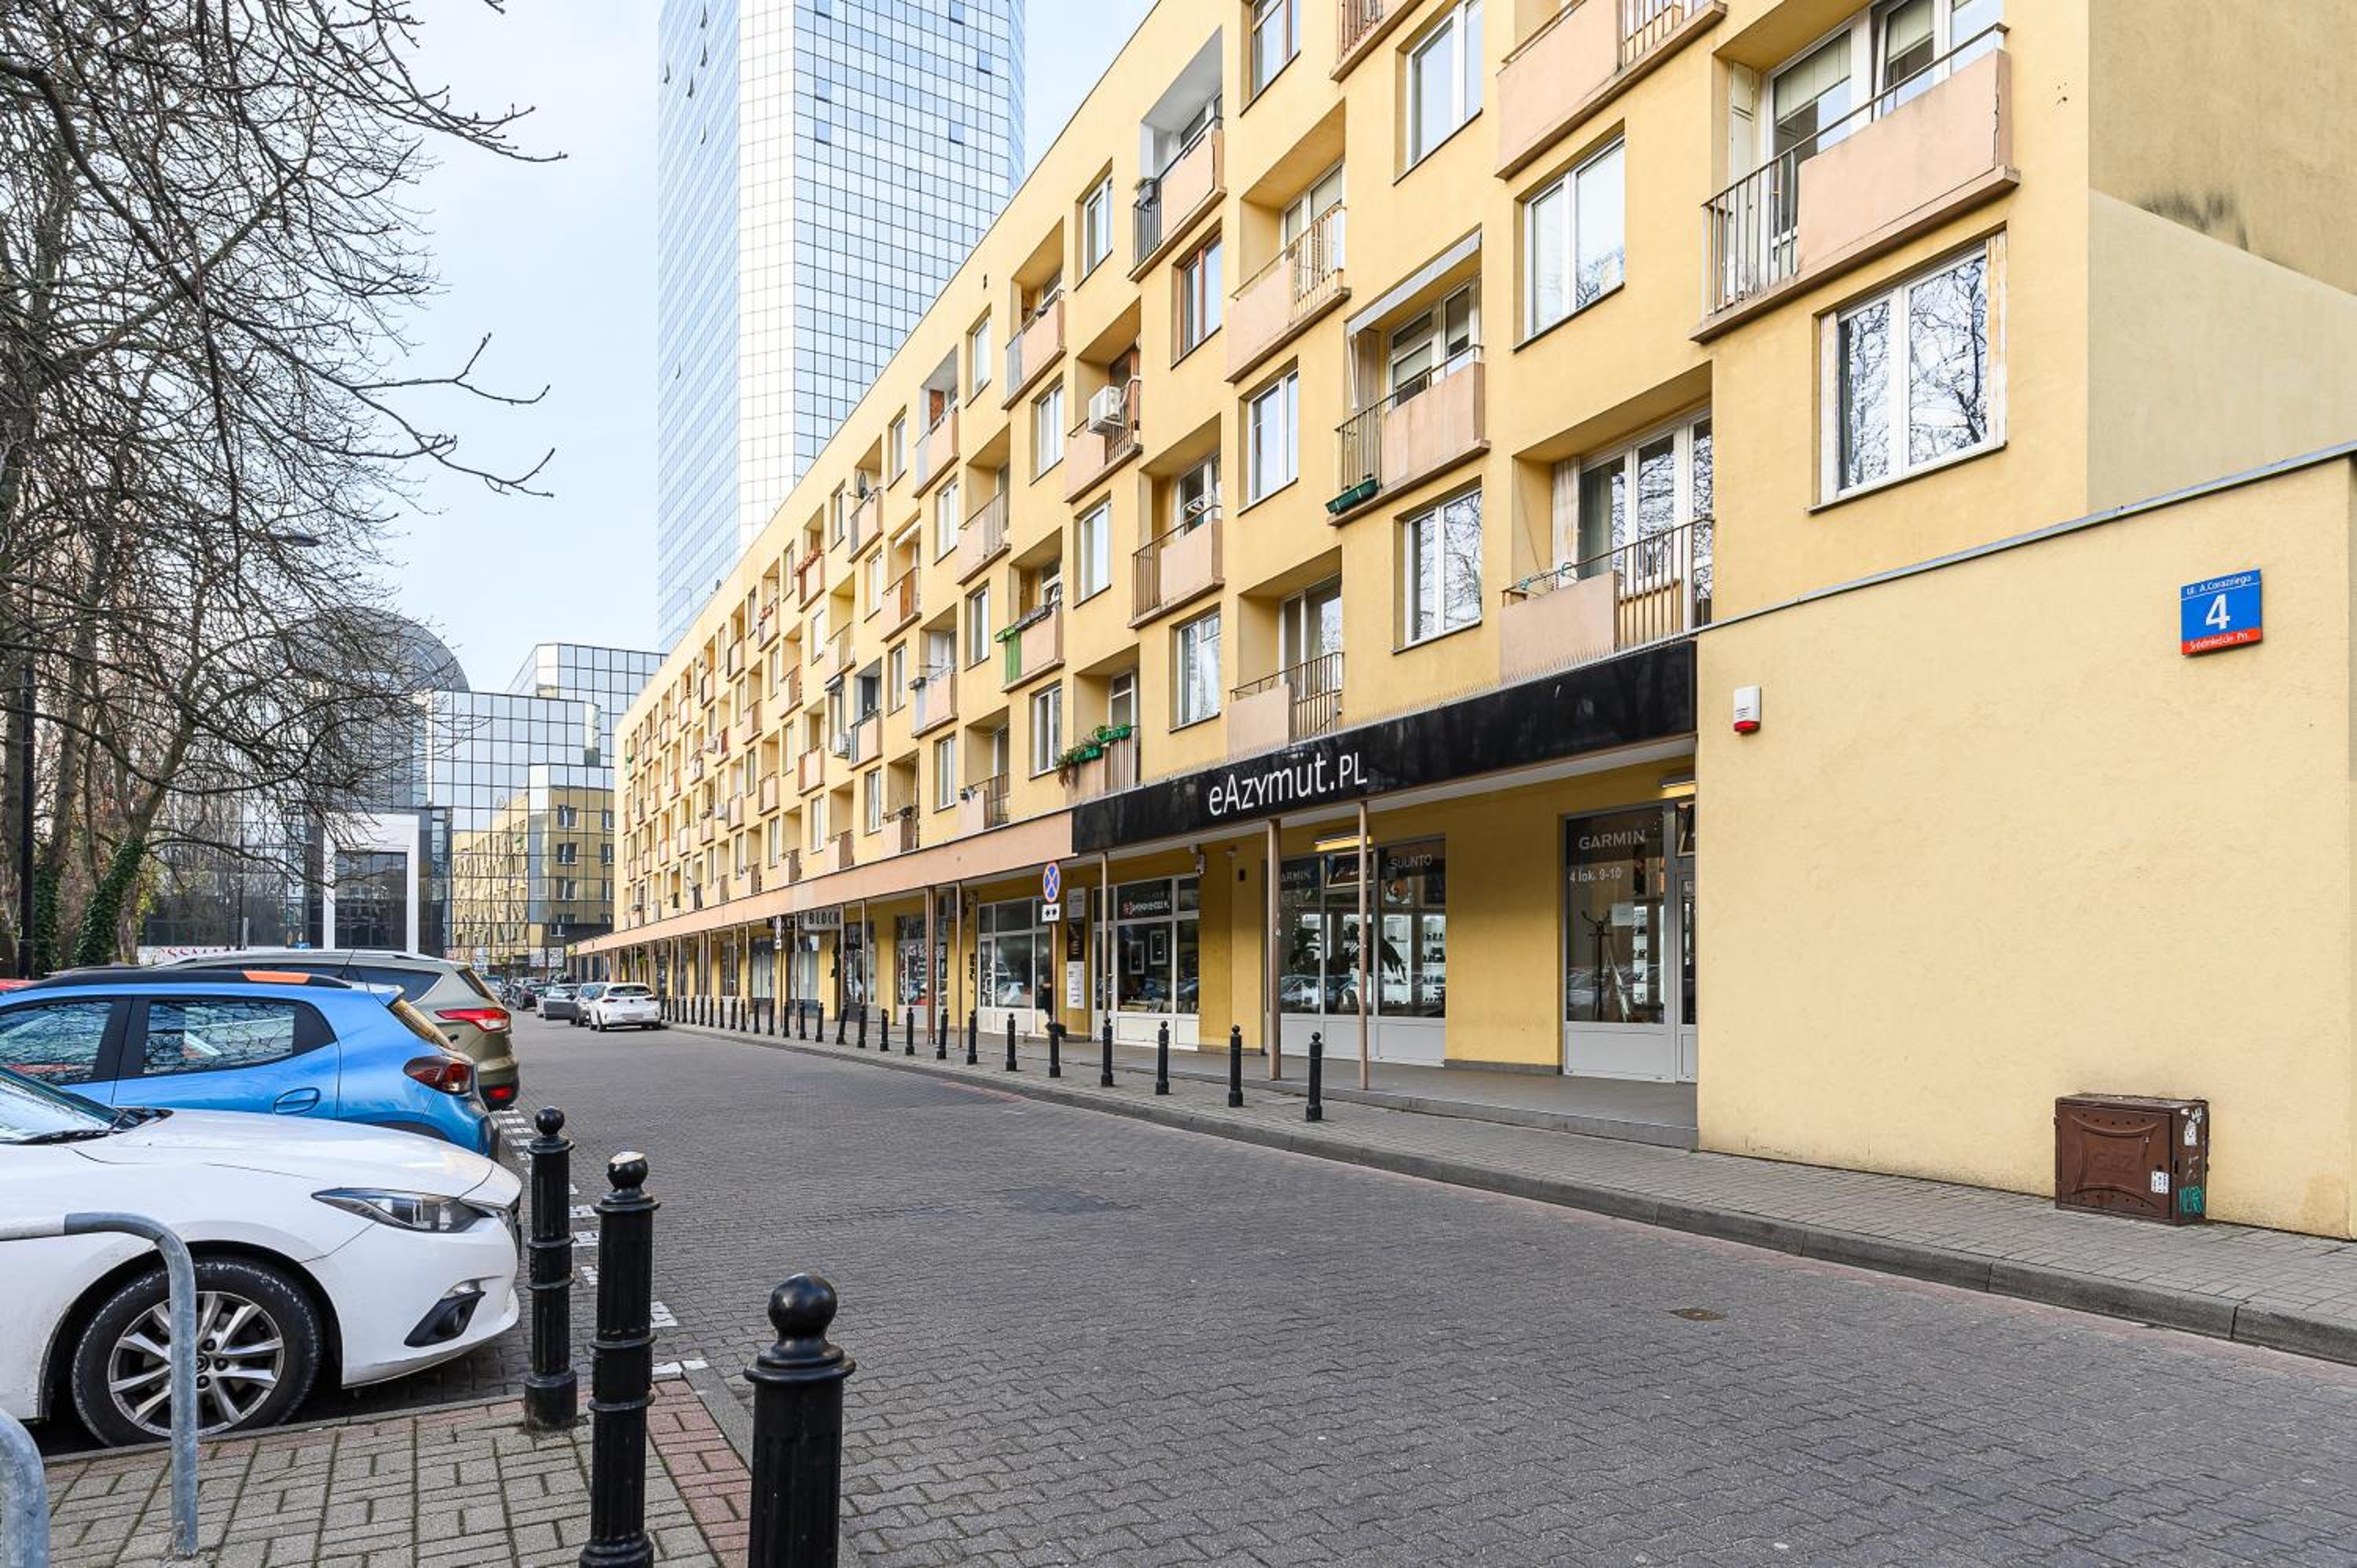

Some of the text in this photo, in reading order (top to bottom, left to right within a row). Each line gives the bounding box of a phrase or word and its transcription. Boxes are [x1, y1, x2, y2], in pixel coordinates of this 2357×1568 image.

[2205, 593, 2231, 629] 4
[1578, 830, 1646, 850] GARMIN
[1390, 853, 1432, 868] SUUNTO
[1569, 870, 1575, 883] 4
[1599, 866, 1622, 881] 9-10
